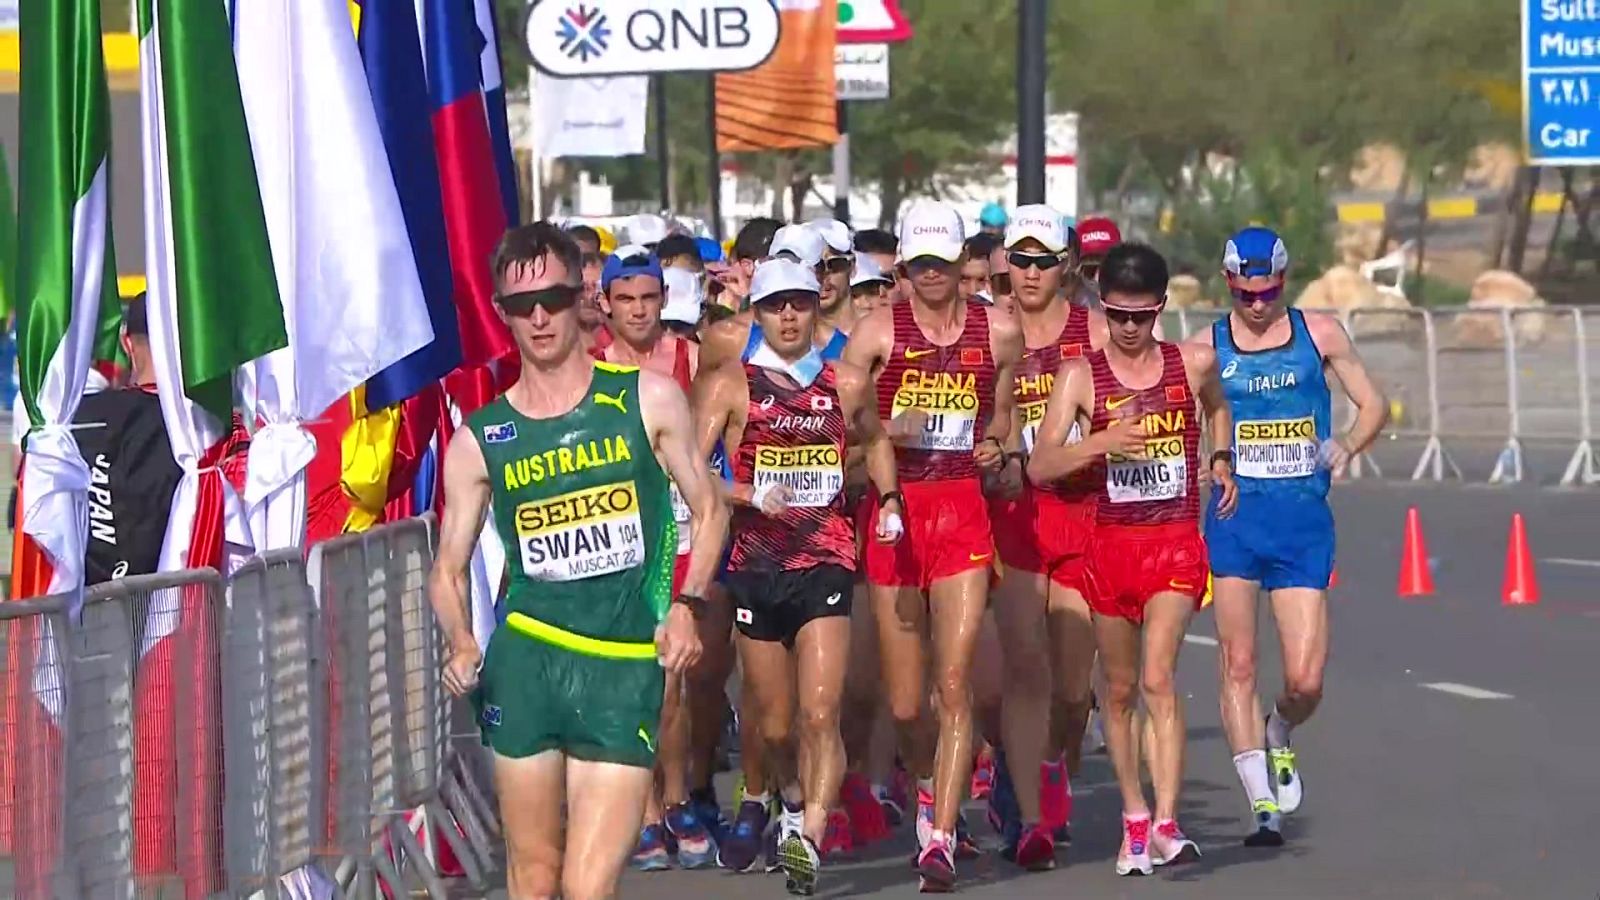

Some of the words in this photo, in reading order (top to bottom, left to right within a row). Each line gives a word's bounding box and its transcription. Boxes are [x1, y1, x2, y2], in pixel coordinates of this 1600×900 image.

[1541, 0, 1600, 21] Sult
[627, 7, 750, 51] QNB
[1540, 33, 1600, 56] Mus
[1540, 122, 1590, 147] Car
[913, 225, 949, 235] CHINA
[1018, 218, 1052, 229] CHINA
[902, 369, 976, 391] CHINA
[1249, 372, 1295, 392] ITALIA
[896, 391, 976, 410] SEIKO
[770, 415, 825, 429] JAPAN
[1240, 420, 1313, 439] SEIKO
[504, 435, 631, 490] AUSTRALIA
[760, 448, 839, 467] SEIKO
[1239, 443, 1302, 462] PICCHIOTTINO
[1112, 463, 1170, 487] WANG
[88, 454, 117, 545] JAPAN
[519, 487, 632, 531] SEIKO
[527, 523, 612, 564] SWAN
[618, 523, 639, 545] 104
[568, 553, 621, 576] MUSCAT
[622, 549, 639, 566] 22
